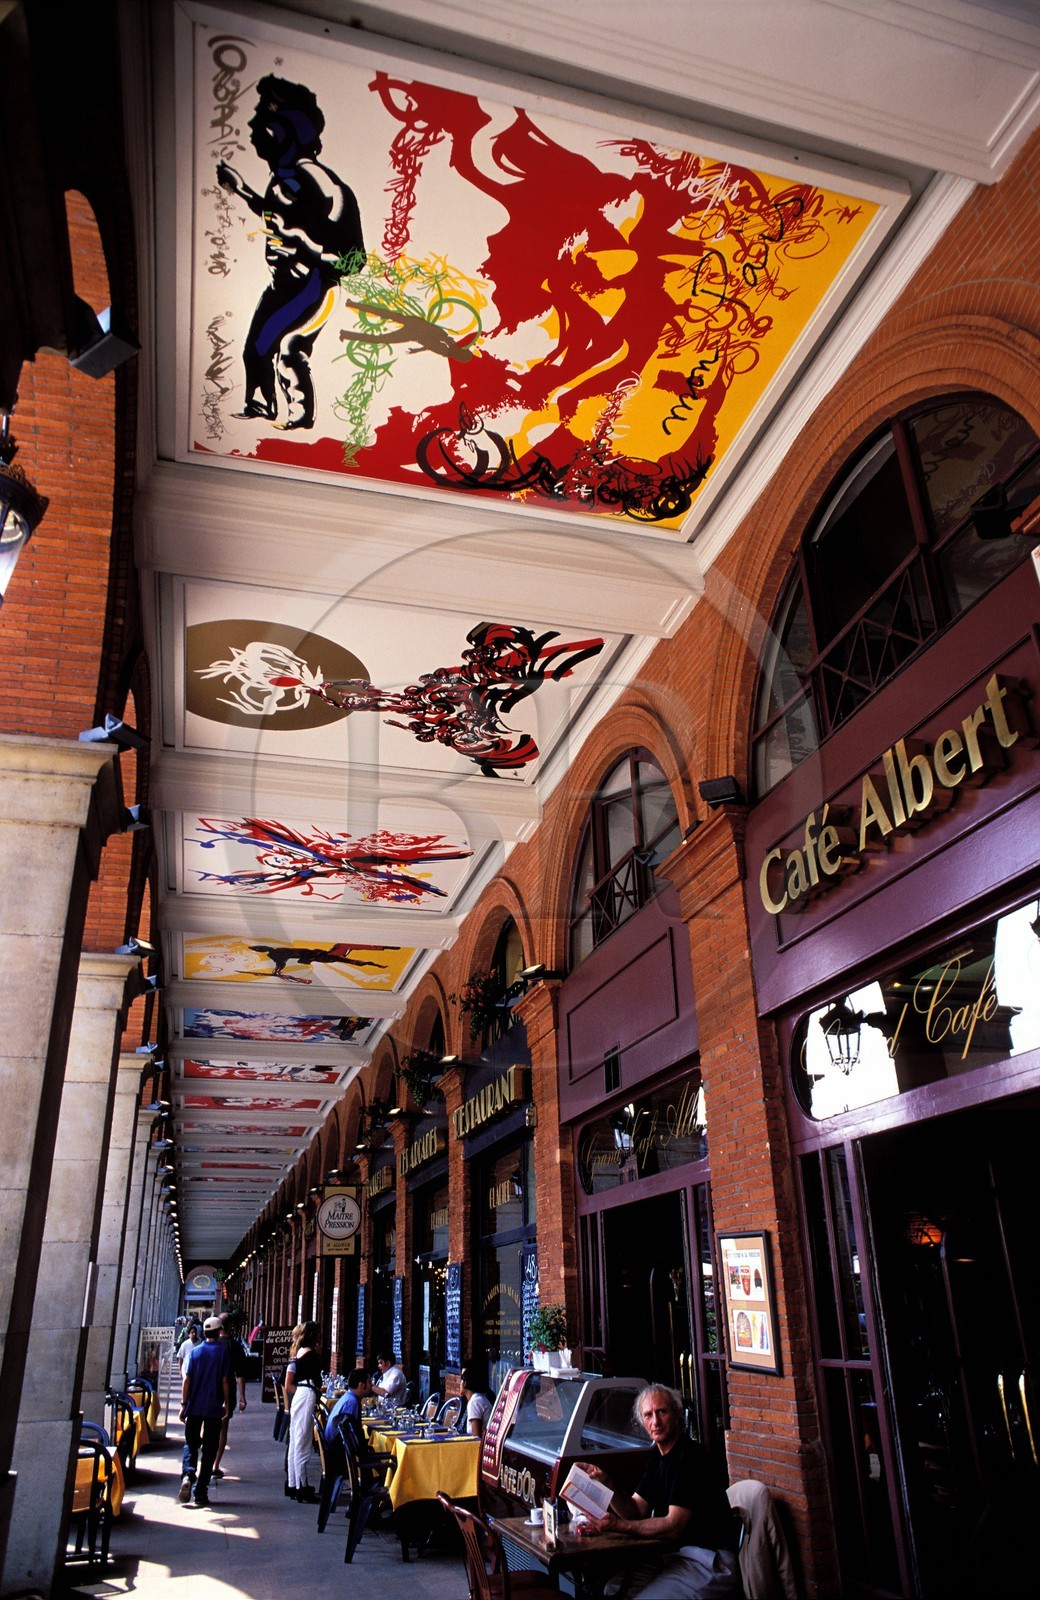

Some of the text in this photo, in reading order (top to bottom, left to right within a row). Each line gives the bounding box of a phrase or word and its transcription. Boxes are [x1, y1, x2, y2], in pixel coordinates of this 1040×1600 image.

[759, 673, 1020, 915] Café Albert
[453, 1064, 517, 1140] RESTAURANT
[410, 1125, 438, 1169] ARCADES
[324, 1219, 355, 1229] PRESSION
